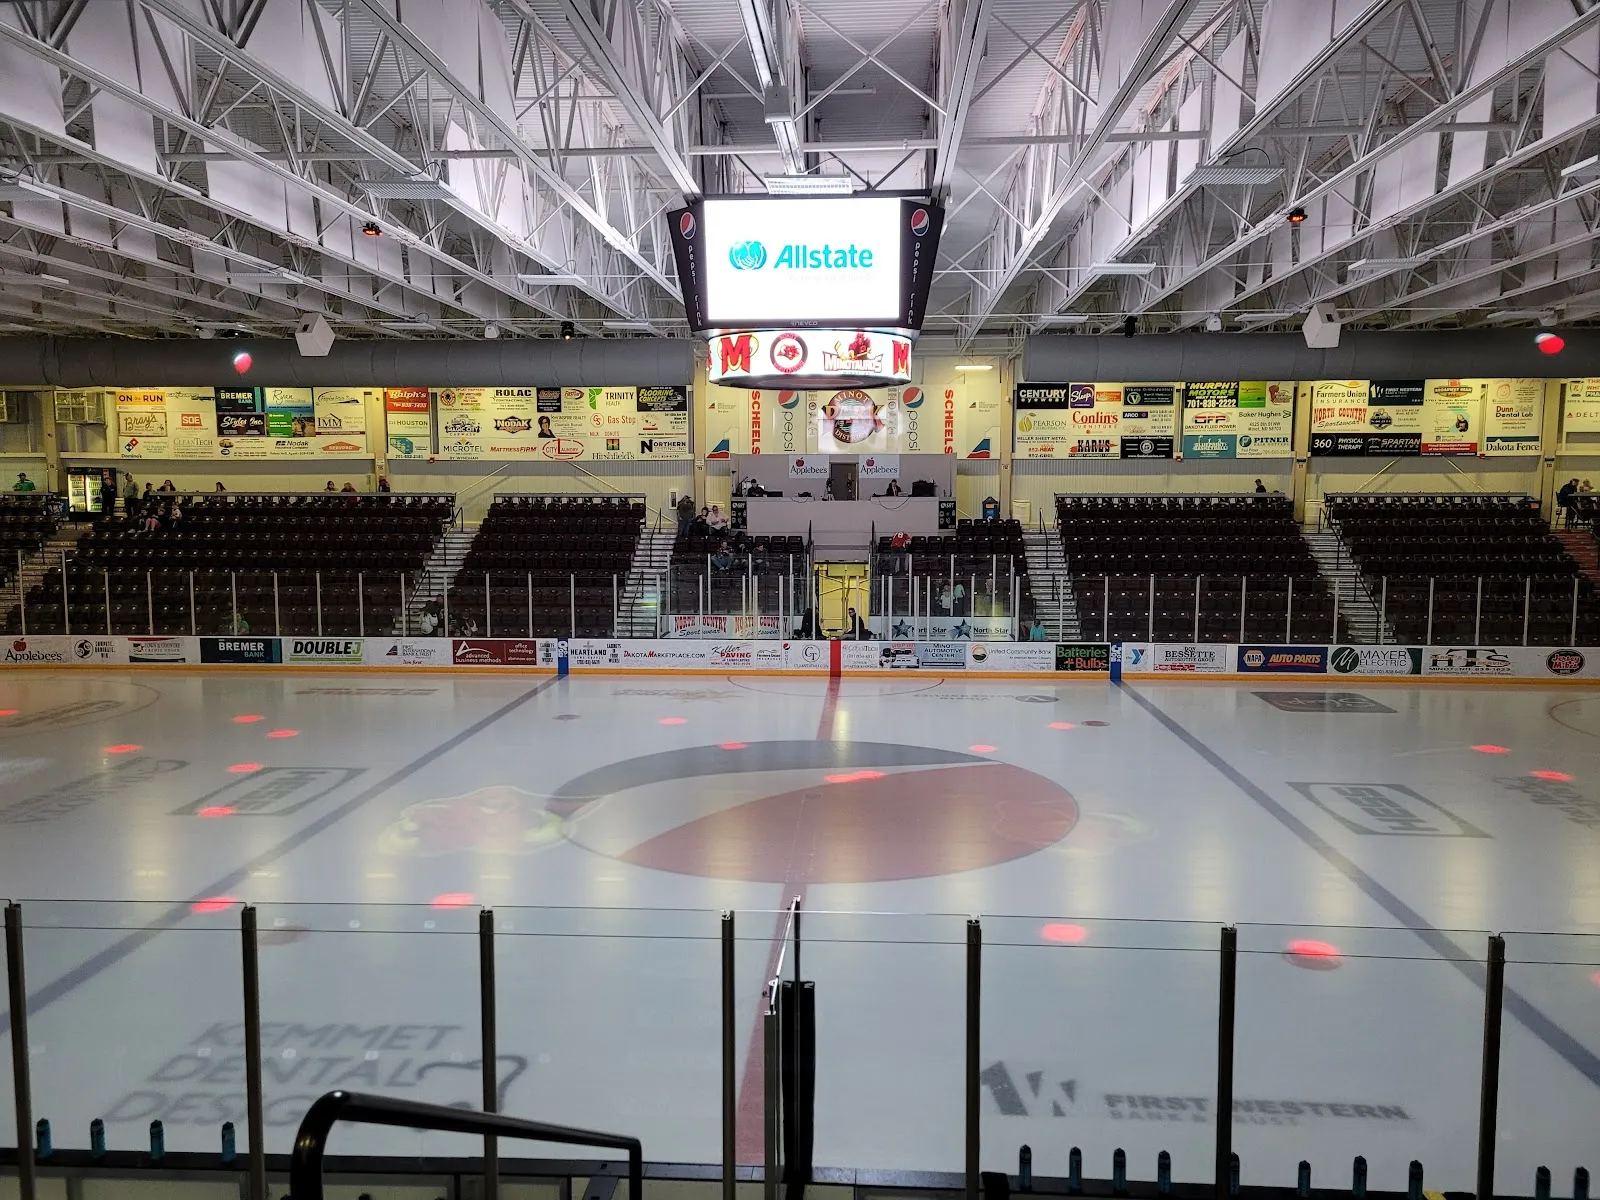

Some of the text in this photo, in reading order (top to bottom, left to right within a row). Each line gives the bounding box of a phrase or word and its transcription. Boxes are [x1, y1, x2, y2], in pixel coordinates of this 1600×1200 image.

[773, 243, 873, 270] Allstate
[913, 241, 921, 283] pepsi
[688, 245, 697, 286] pepsi
[694, 294, 702, 326] rink
[907, 292, 915, 325] rink
[822, 350, 884, 373] MINOTAUROS
[1190, 382, 1237, 390] MURPHY
[118, 394, 163, 402] ON RUN
[220, 392, 253, 400] BREMER
[389, 389, 427, 400] Ralph's
[495, 389, 532, 397] ROLAC
[605, 391, 635, 400] TRINITY
[639, 388, 674, 397] FLOORING
[837, 390, 870, 404] MINOT
[1019, 389, 1067, 399] CENTURY
[1188, 389, 1235, 397] MOTORS
[1316, 390, 1367, 398] Farmers Union
[639, 395, 667, 403] CONCEPTS
[1186, 399, 1237, 408] 701-838-2222
[607, 415, 620, 425] Gas
[621, 415, 636, 425] Stop
[1072, 410, 1118, 424] Conlin's
[1313, 407, 1367, 423] NORTH COUNTRY
[497, 419, 529, 428] NODAK
[751, 390, 761, 455] SCHEELS
[944, 389, 954, 454] SCHEELS
[1317, 420, 1360, 429] Sportswear
[782, 411, 796, 452] pepsi
[907, 410, 921, 451] pepsi
[443, 445, 485, 453] MICROTEL
[1077, 439, 1110, 453] KARL'S
[1313, 439, 1333, 448] 360
[1486, 443, 1540, 452] Dakota Fence
[545, 446, 558, 454] CITY
[592, 451, 635, 460] Hirshfield's
[790, 464, 828, 475] Applebee's
[674, 616, 696, 633] NORTH
[218, 642, 265, 651] BREMER
[1056, 645, 1108, 658] Batteries
[4, 650, 63, 663] Applebee's
[1164, 650, 1216, 658] BESSETTE
[1246, 653, 1322, 664] NAPA AUTO PARTS
[1359, 650, 1407, 659] MAYER
[1552, 654, 1581, 663] Jersey
[1075, 657, 1108, 668] Bulbs
[1359, 659, 1407, 667] ELECTRIC
[188, 1021, 464, 1051] KEMMET
[146, 1054, 420, 1088] DENTAL
[1103, 1093, 1210, 1113] FIRST
[1109, 1110, 1184, 1122] BANK
